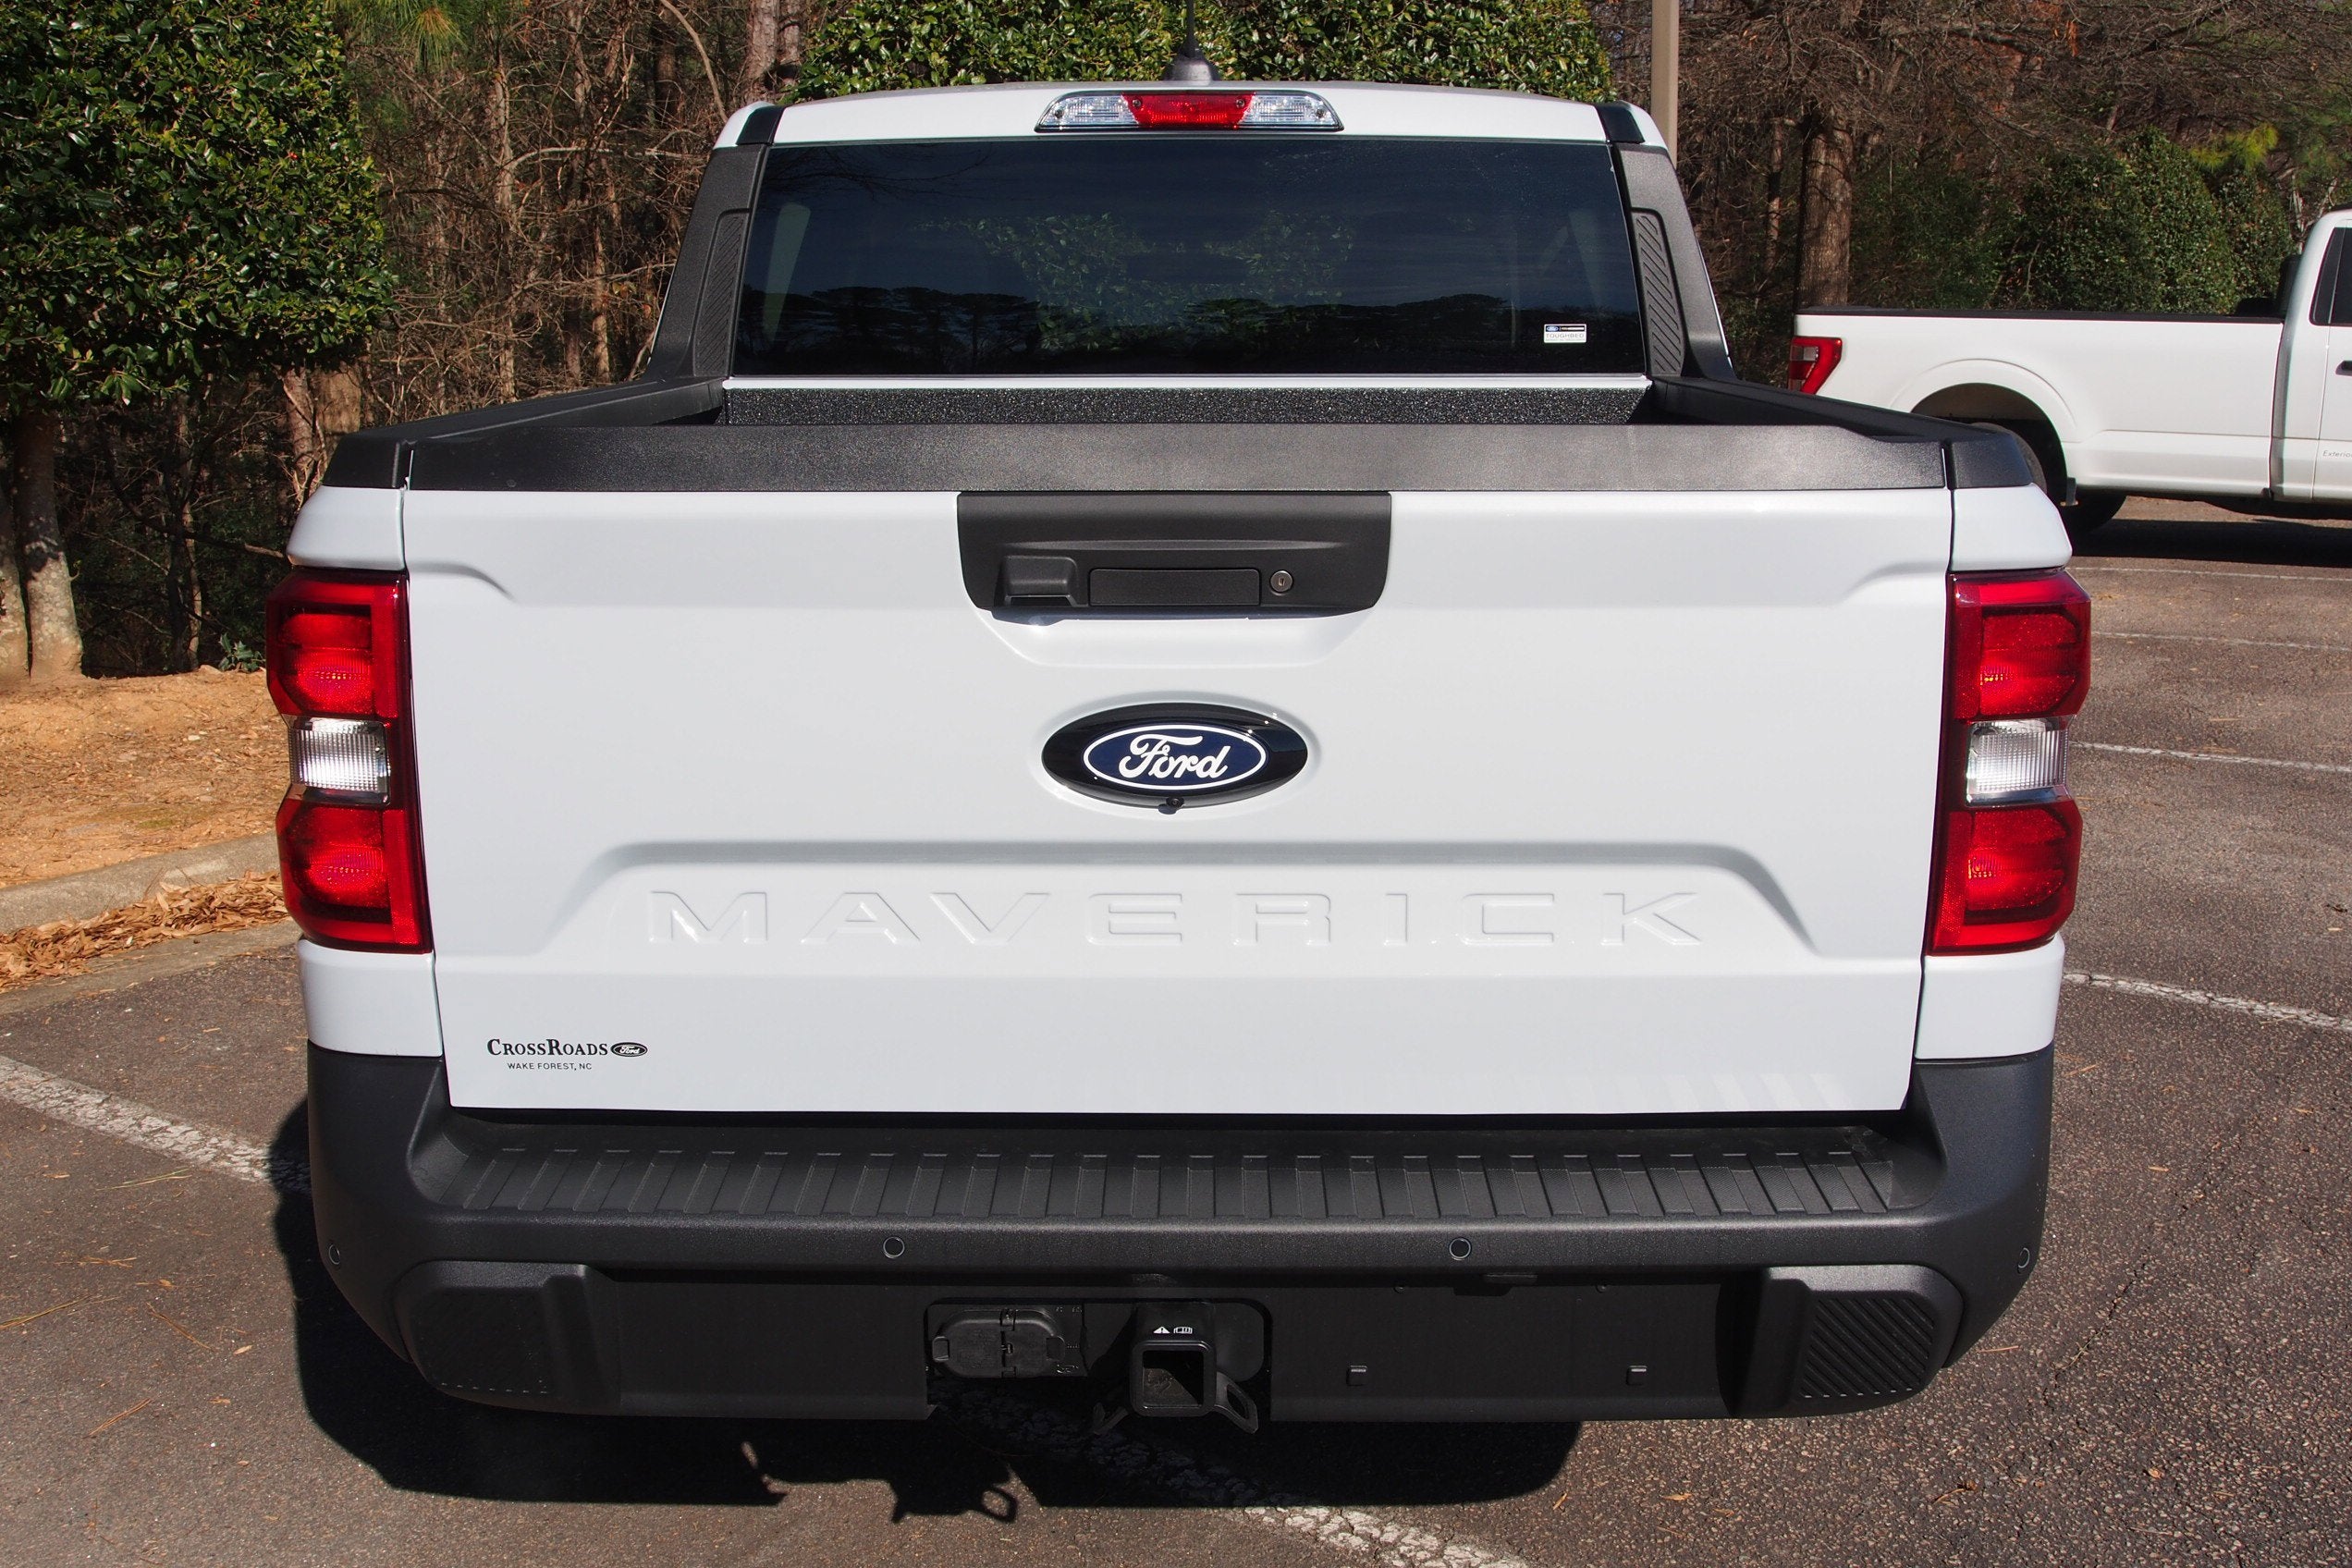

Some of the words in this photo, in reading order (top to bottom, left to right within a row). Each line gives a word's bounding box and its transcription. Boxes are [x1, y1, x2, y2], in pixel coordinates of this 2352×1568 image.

[2322, 449, 2352, 458] Exterio
[1118, 733, 1231, 778] Ford
[649, 891, 1701, 945] MAVERICK
[537, 1062, 577, 1071] FOREST,
